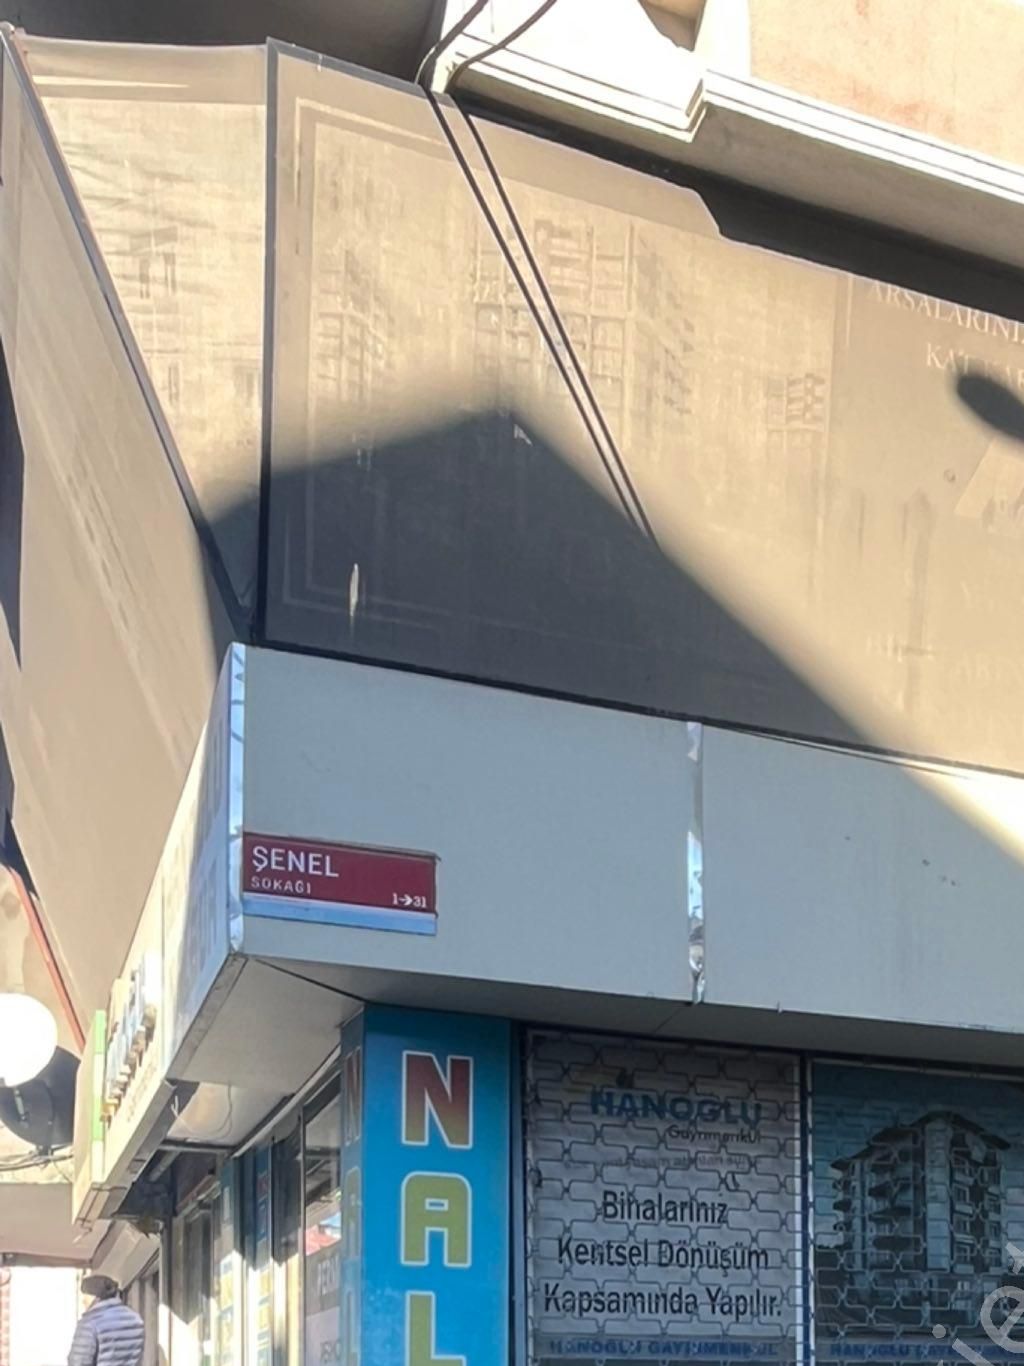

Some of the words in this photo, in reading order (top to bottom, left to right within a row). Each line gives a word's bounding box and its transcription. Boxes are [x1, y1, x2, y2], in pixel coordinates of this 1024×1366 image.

[252, 846, 339, 877] ŞENEL
[558, 1236, 649, 1268] Kentsel
[658, 1239, 769, 1278] Dönüşüm
[544, 1283, 698, 1318] Kapsamında
